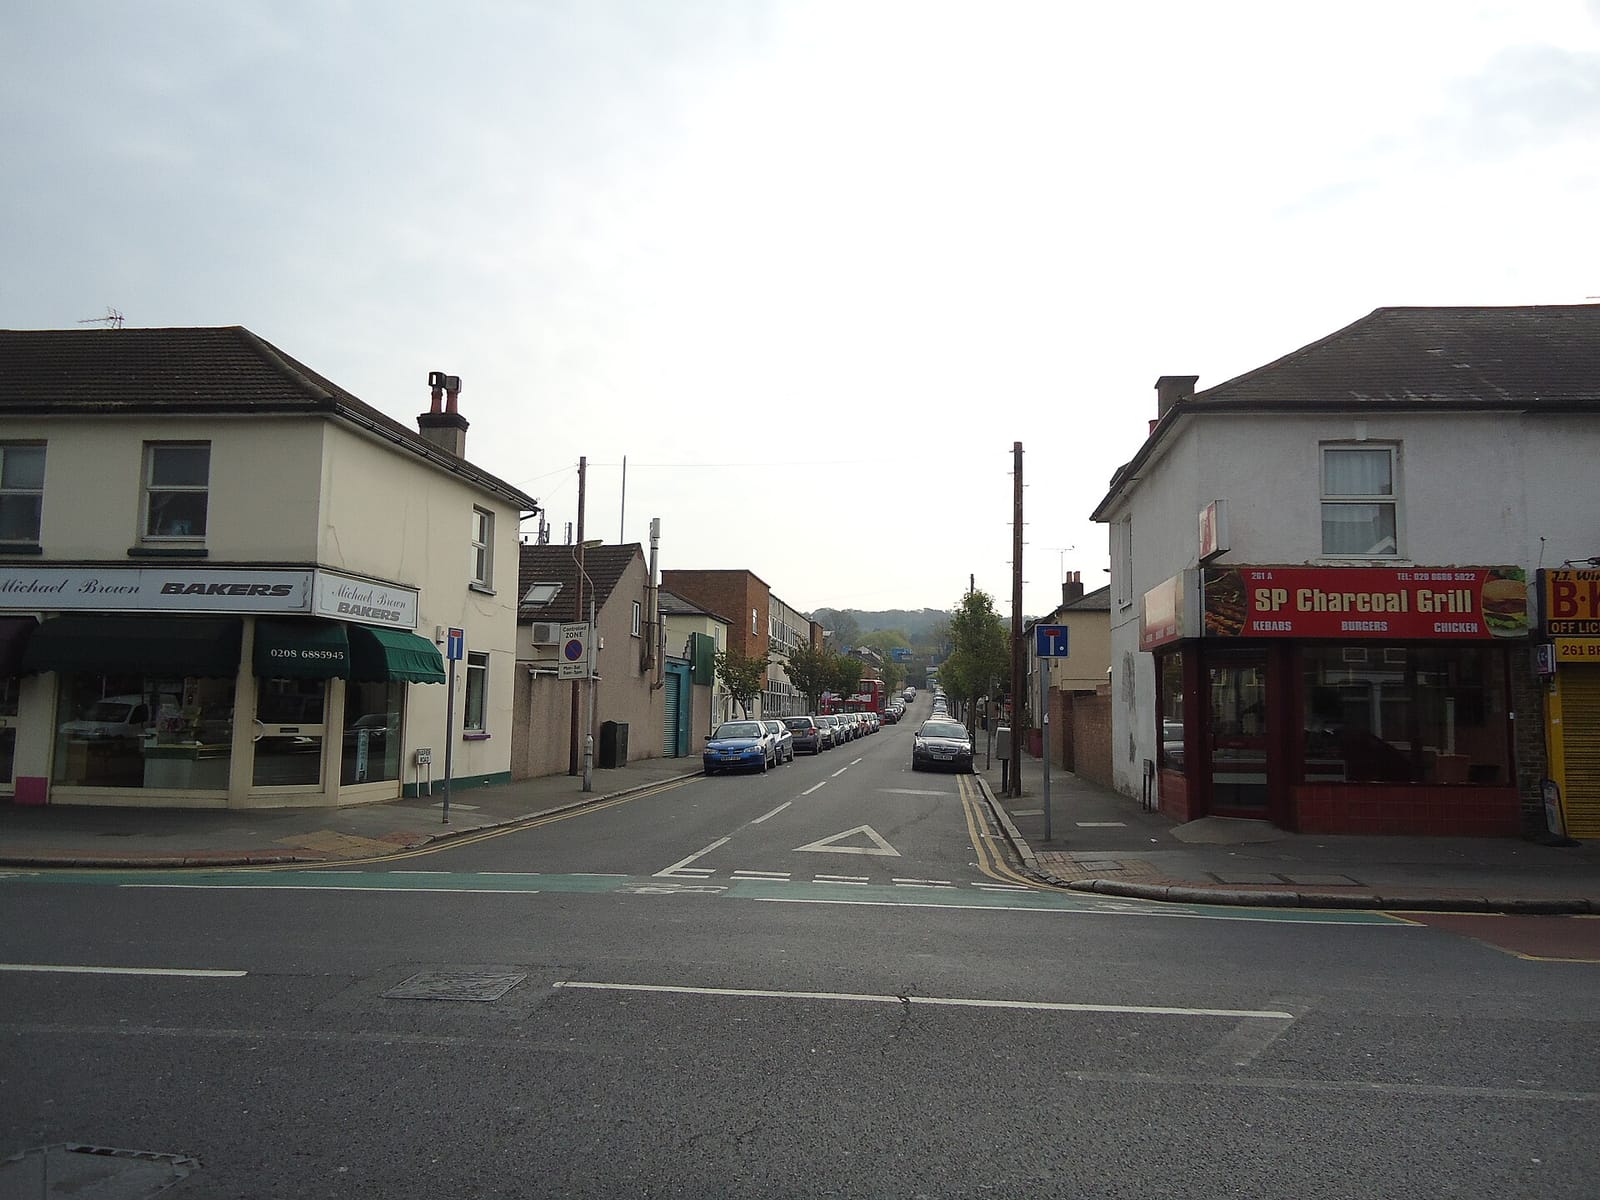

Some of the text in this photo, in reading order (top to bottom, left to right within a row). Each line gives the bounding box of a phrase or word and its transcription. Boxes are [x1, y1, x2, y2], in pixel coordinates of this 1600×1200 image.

[78, 579, 140, 594] Brown
[160, 582, 293, 597] BAKERS
[331, 584, 406, 609] Michael Brown
[1254, 588, 1472, 613] SP Charcoal Grill
[337, 601, 401, 622] BAKERS
[1253, 620, 1478, 633] KEBABS BURGERS CHICKEN
[1551, 622, 1575, 633] OFF
[270, 648, 344, 660] 0208 6885945
[1562, 645, 1584, 656] 261
